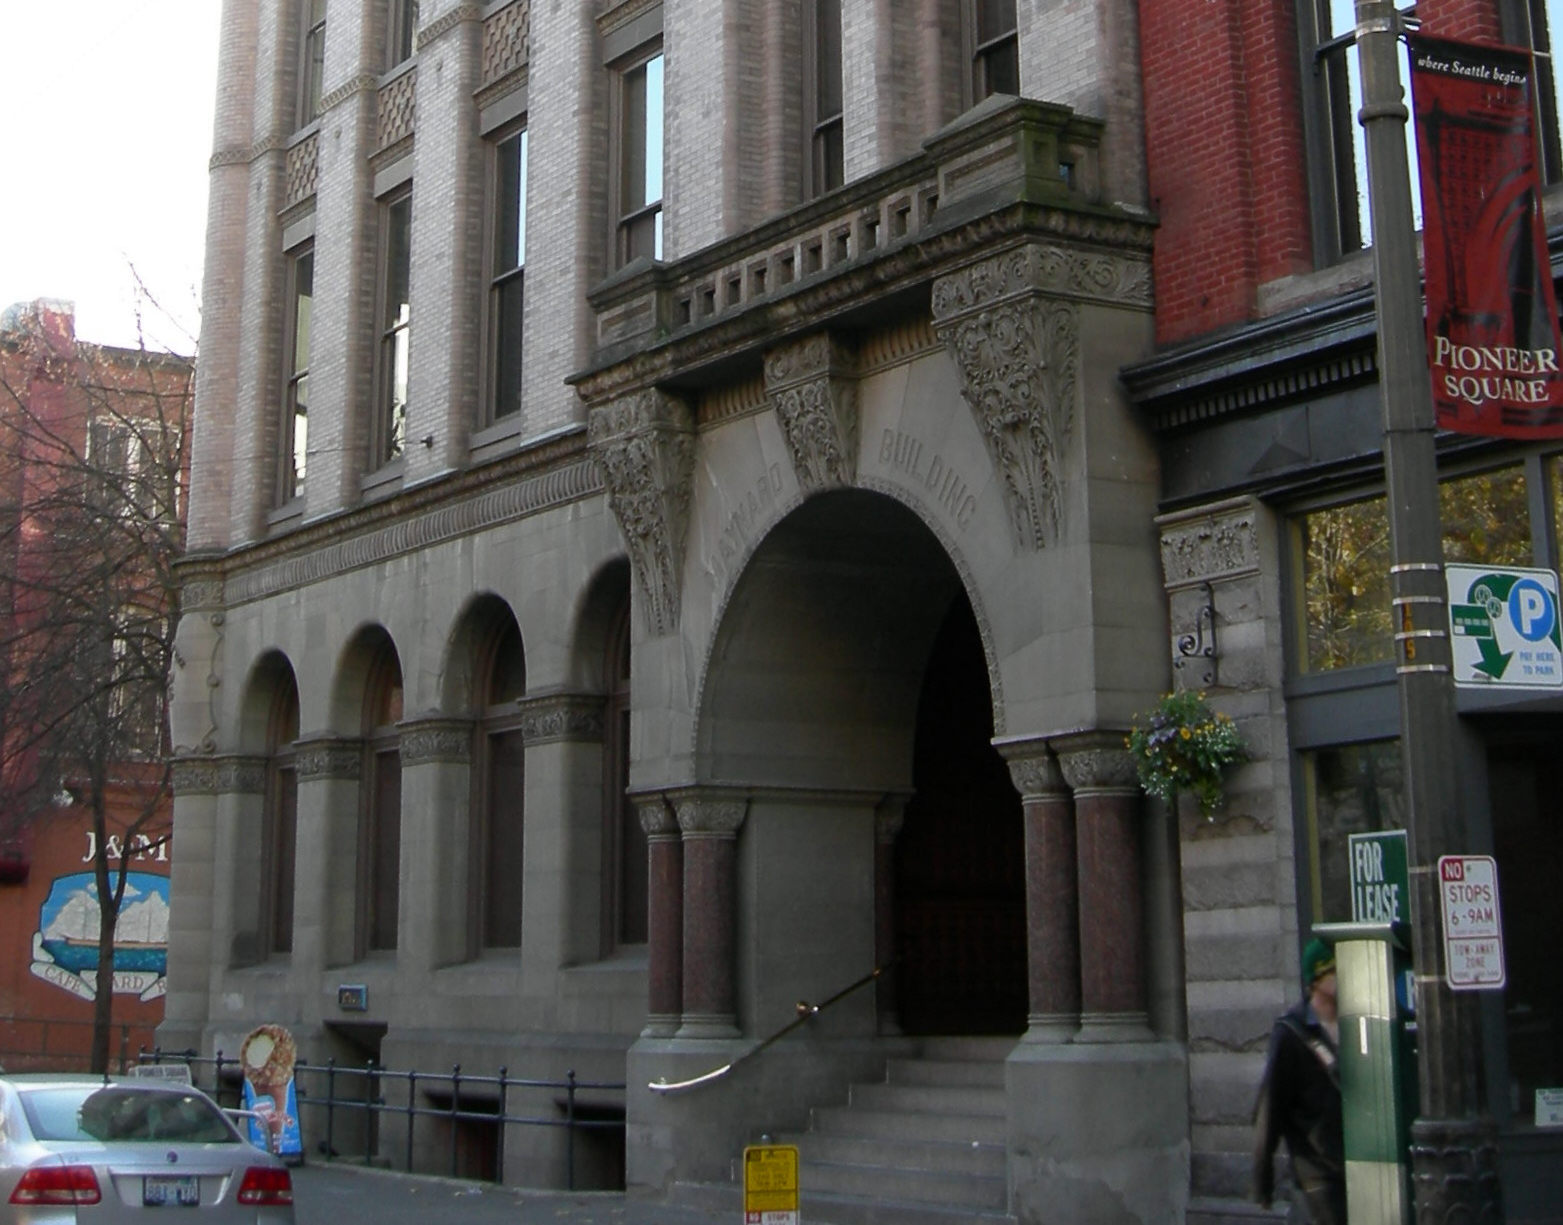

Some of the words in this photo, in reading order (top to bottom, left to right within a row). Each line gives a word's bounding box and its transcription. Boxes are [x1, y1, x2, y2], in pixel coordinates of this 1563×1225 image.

[1417, 55, 1449, 72] where
[1451, 60, 1490, 79] Seattle
[1492, 67, 1527, 85] begins
[1433, 335, 1560, 374] PIONEER
[1444, 374, 1550, 405] SQUARE
[877, 427, 978, 529] BUILDING
[1518, 588, 1546, 635] P
[1519, 650, 1533, 662] PAY
[1535, 651, 1555, 663] HERE
[1523, 664, 1533, 674] TO
[1535, 664, 1554, 675] PARK
[1354, 841, 1384, 883] FOR
[1444, 861, 1462, 879] NO
[1357, 883, 1401, 923] LEASE
[1448, 884, 1492, 903] STOPS
[44, 965, 81, 992] CAFE
[112, 975, 145, 990] ARD
